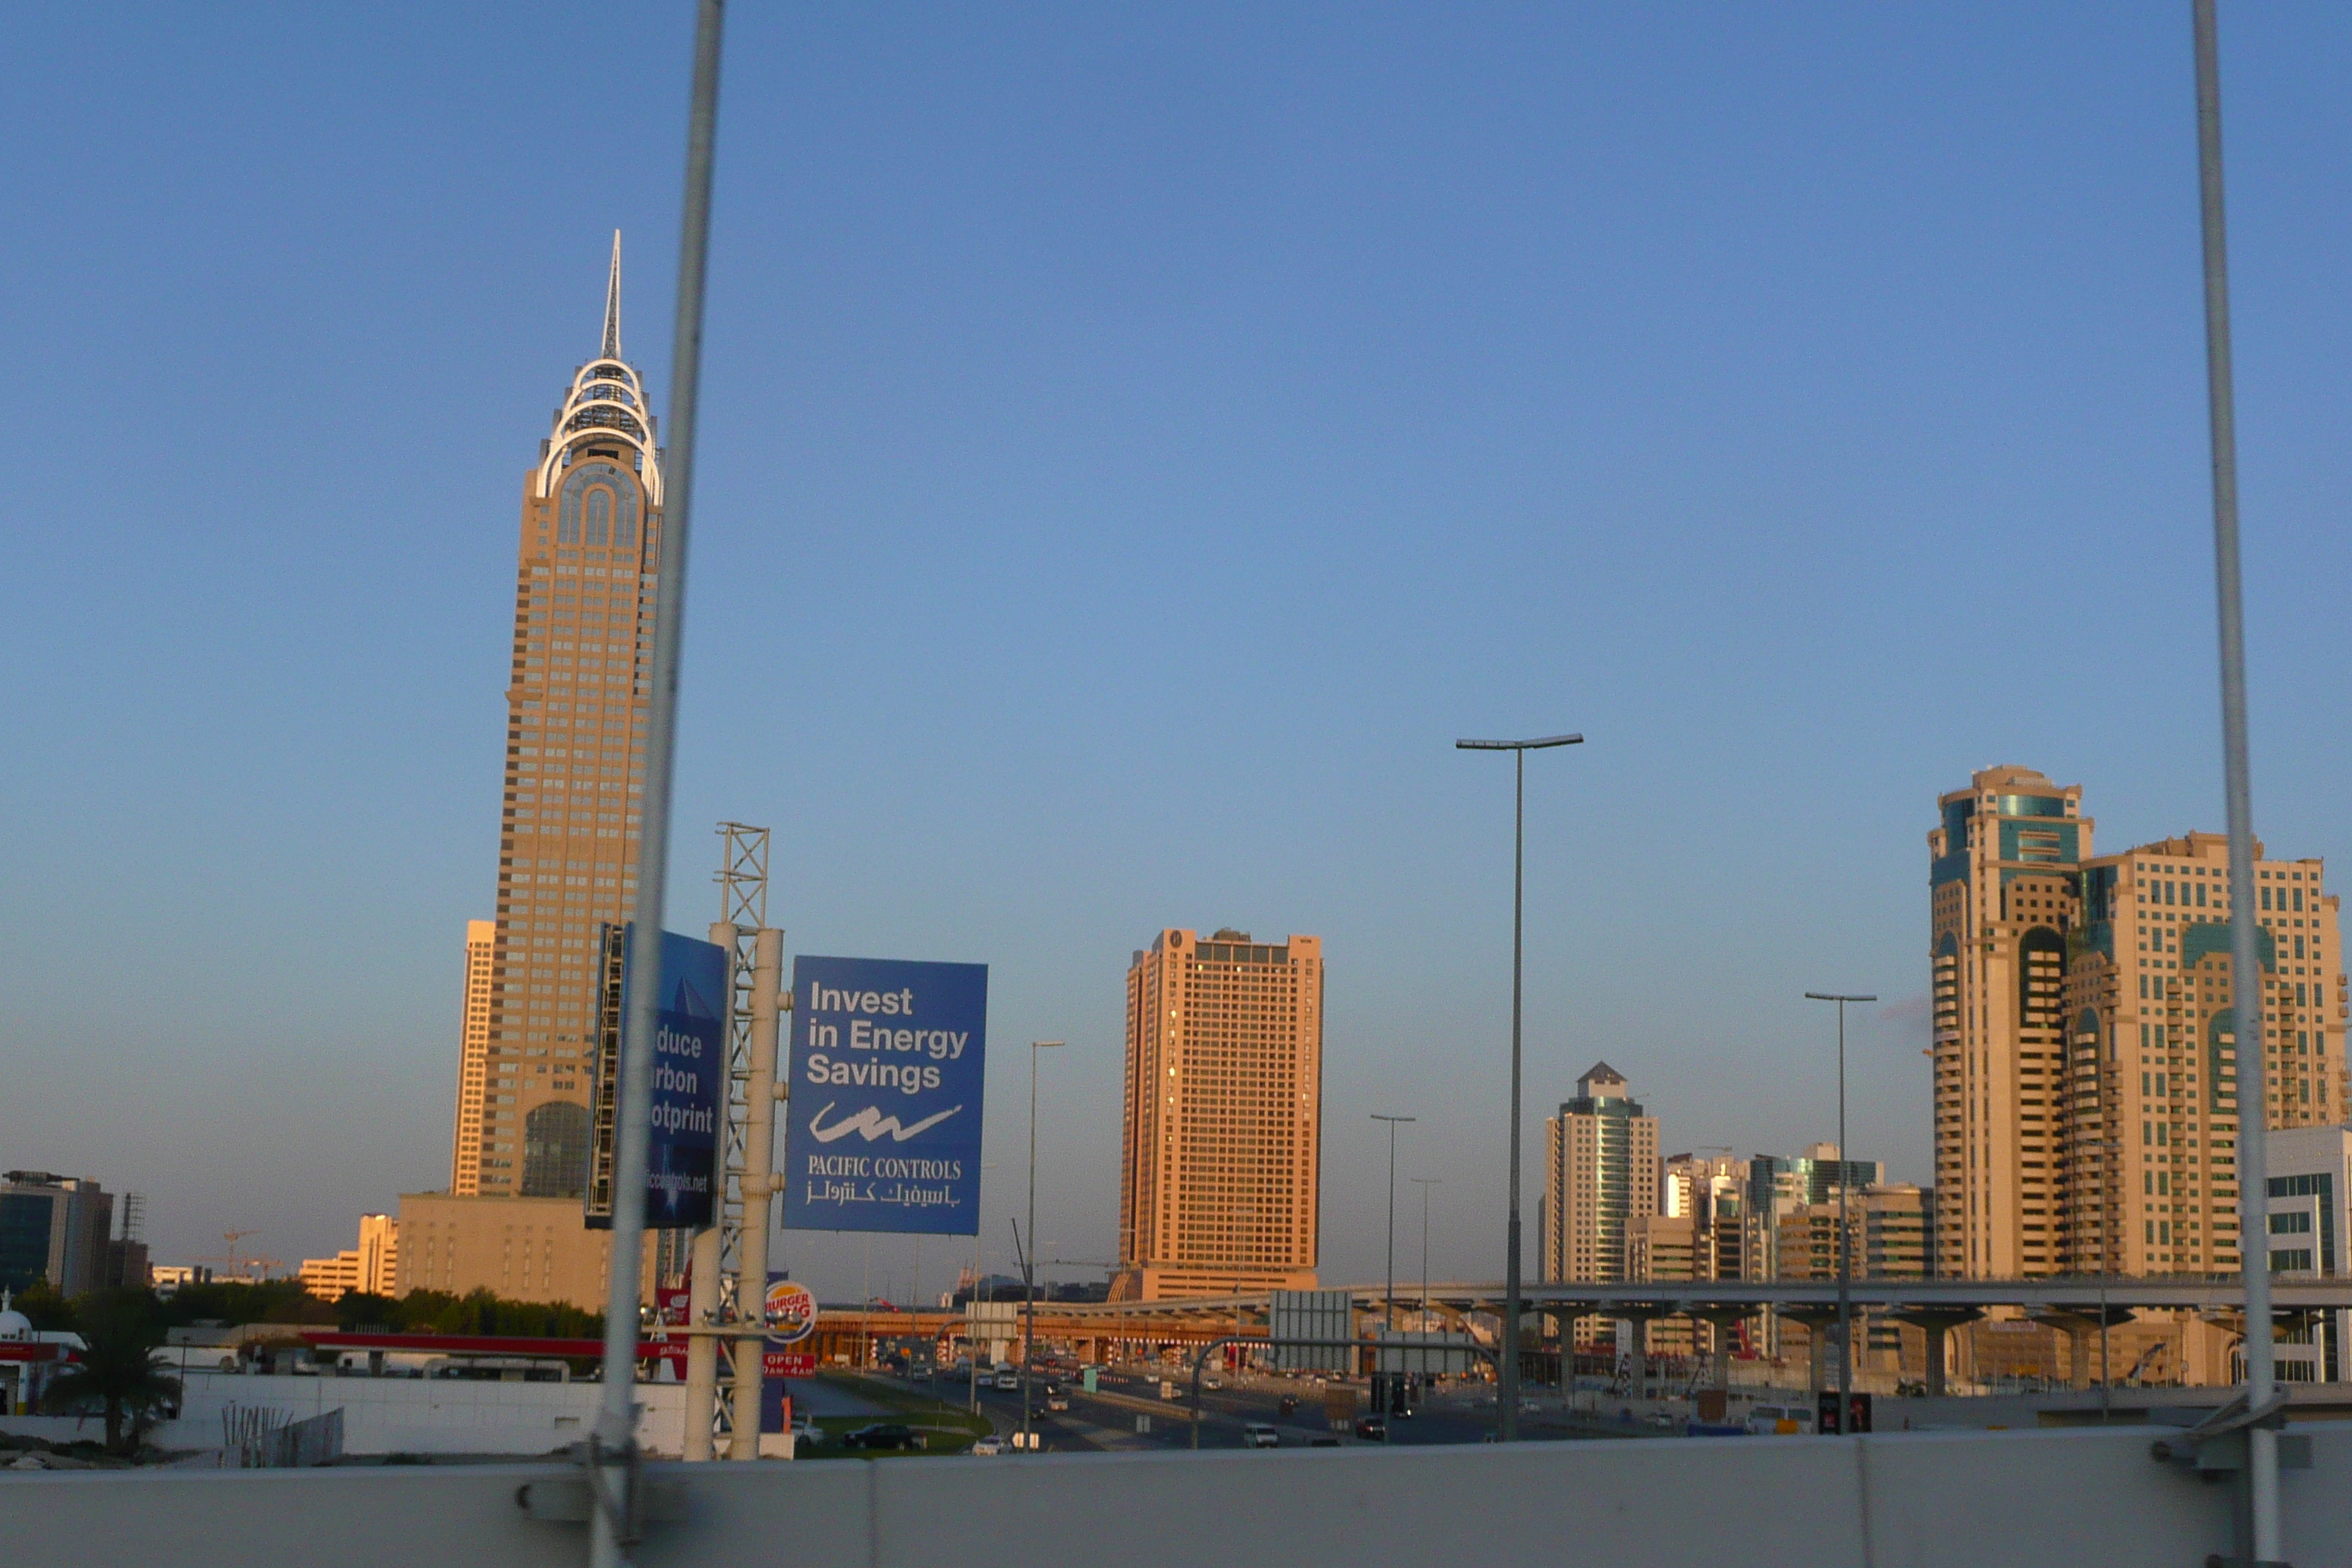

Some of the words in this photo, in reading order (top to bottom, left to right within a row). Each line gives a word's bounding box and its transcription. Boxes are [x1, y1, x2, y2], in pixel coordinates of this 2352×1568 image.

[810, 981, 913, 1015] Invest
[657, 1024, 702, 1058] duce
[809, 1017, 838, 1047] in
[850, 1019, 968, 1060] Energy
[655, 1061, 698, 1094] rbon
[807, 1053, 941, 1095] Savings
[651, 1100, 713, 1134] otprint
[808, 1155, 870, 1177] PACIFIC
[874, 1158, 962, 1180] CONTROLS
[765, 1293, 809, 1313] BURGER
[767, 1354, 803, 1365] OPEN
